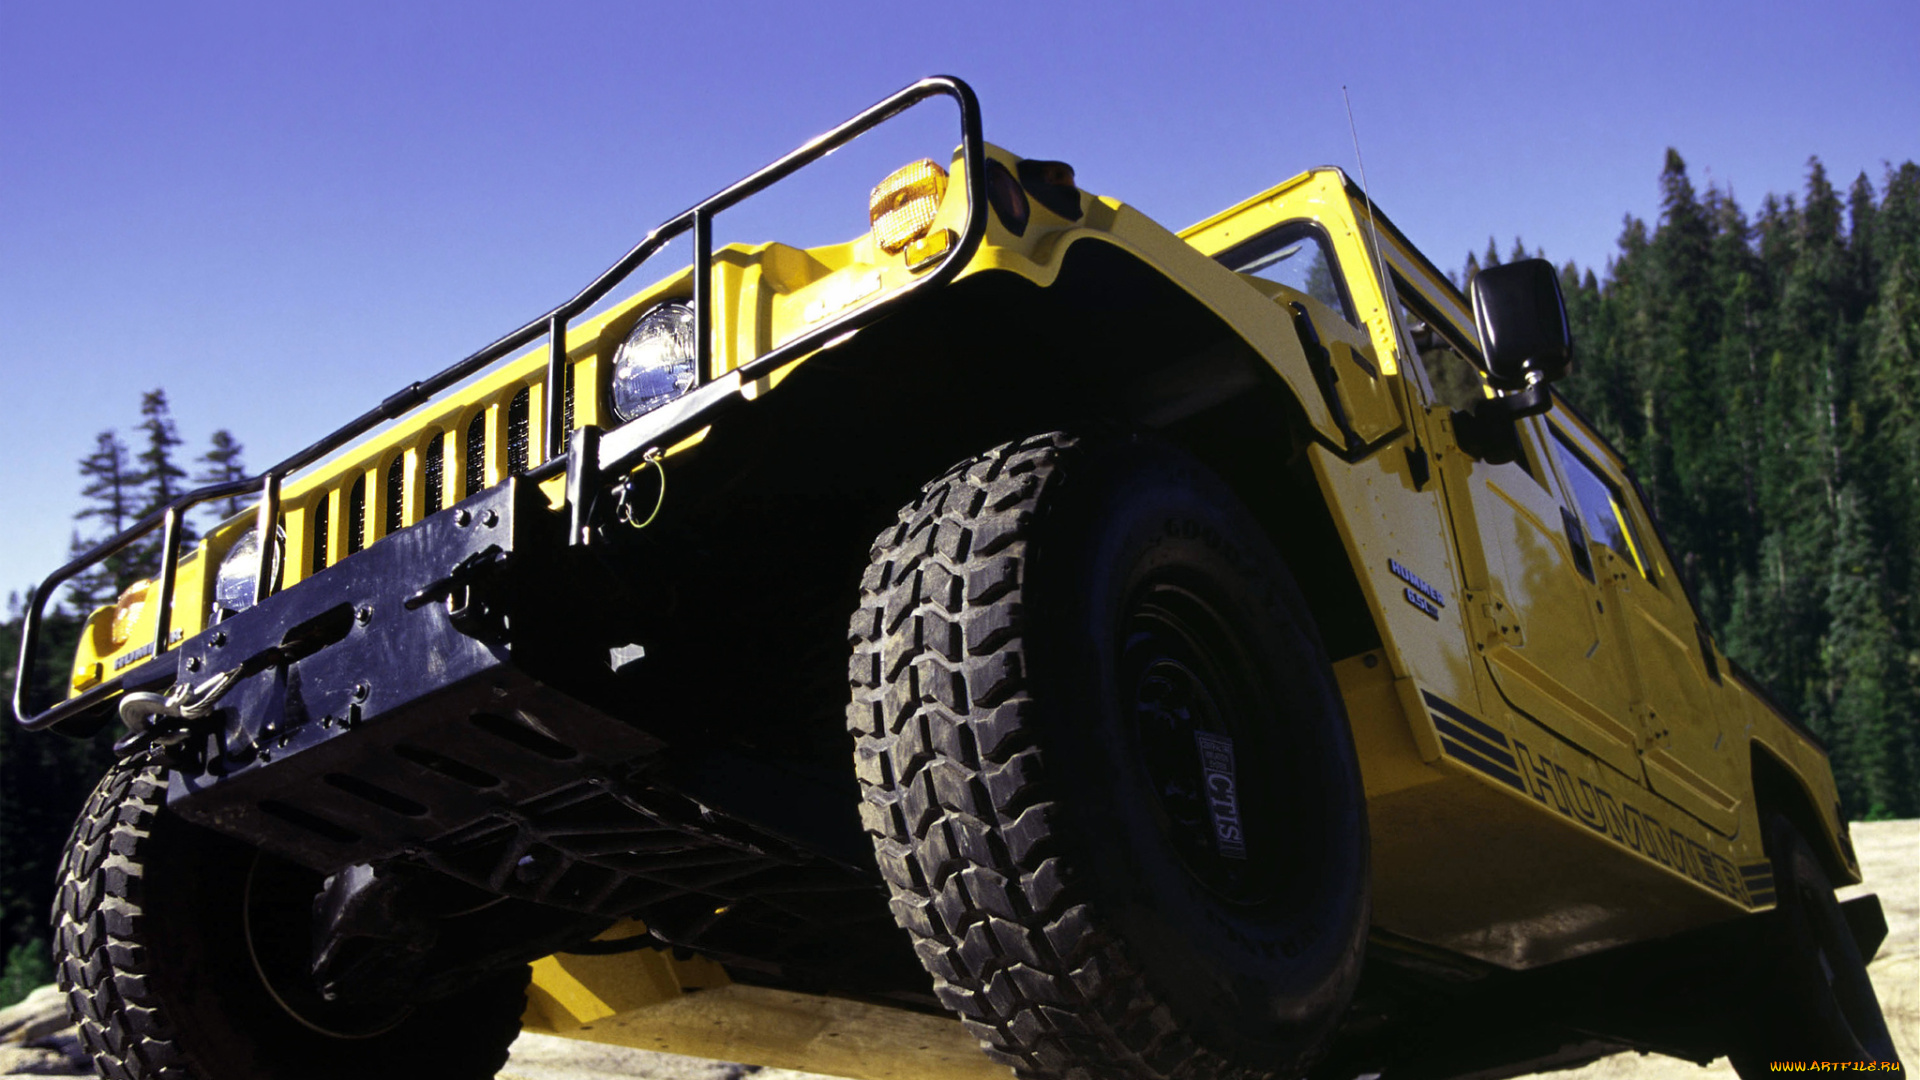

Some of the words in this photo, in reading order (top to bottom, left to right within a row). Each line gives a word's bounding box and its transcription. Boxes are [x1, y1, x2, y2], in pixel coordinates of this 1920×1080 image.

[1388, 558, 1445, 608] HUMMER
[1209, 774, 1240, 840] CTIS
[1514, 738, 1753, 907] HUMMER
